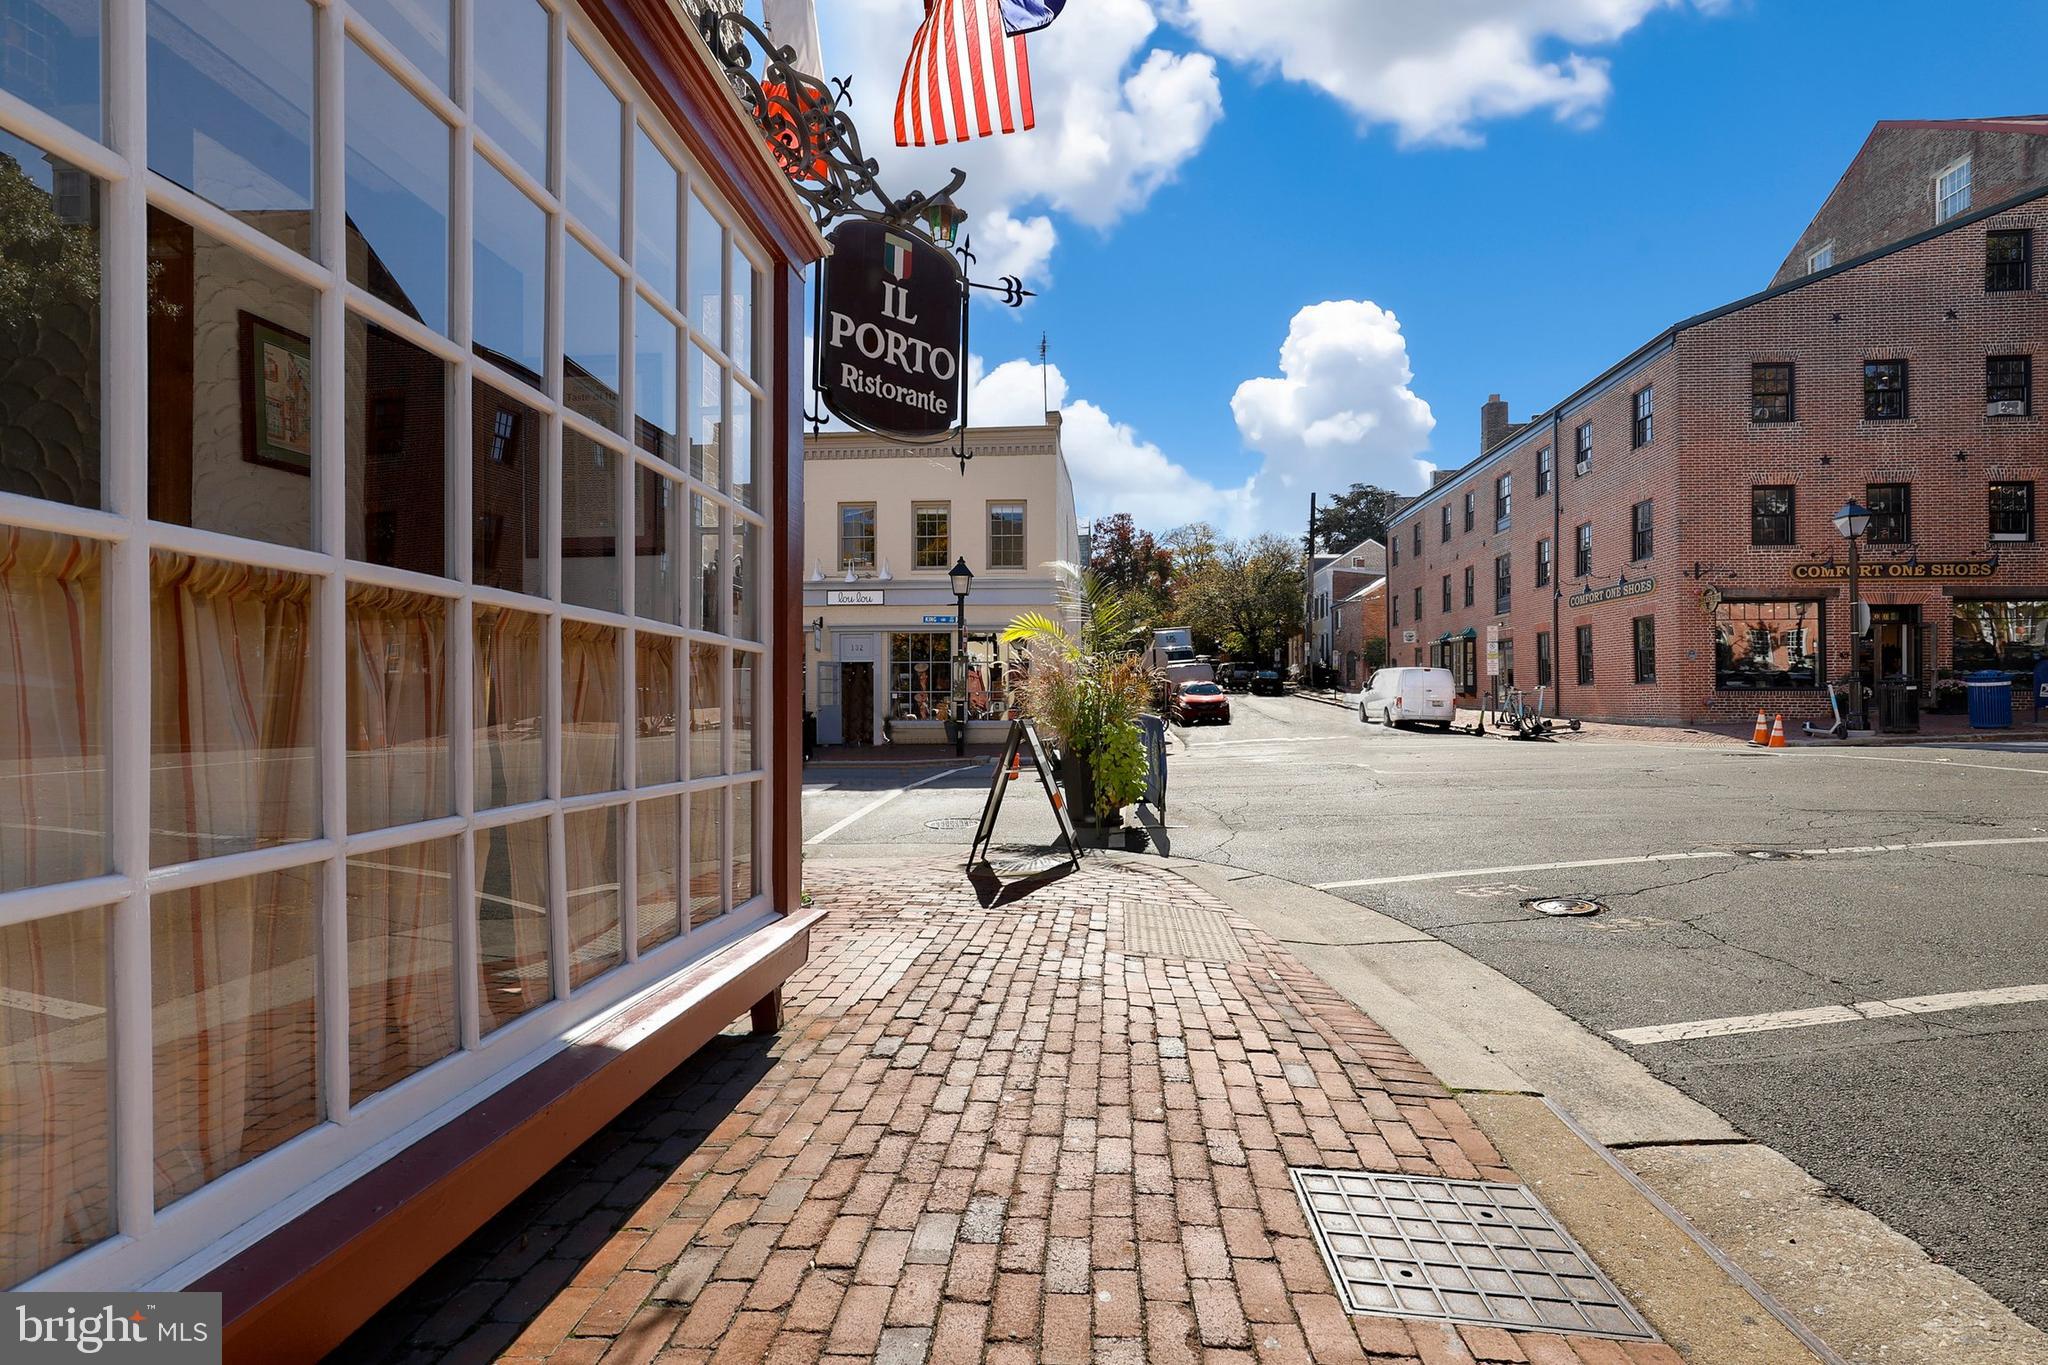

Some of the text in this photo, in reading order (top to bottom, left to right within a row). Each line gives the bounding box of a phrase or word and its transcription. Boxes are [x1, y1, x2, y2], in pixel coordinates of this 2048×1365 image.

[881, 280, 918, 325] IL
[829, 311, 956, 381] PORTO
[840, 363, 948, 415] Ristorante
[1888, 564, 1926, 576] ONE
[1930, 563, 1991, 576] SHOES
[838, 592, 874, 603] lou lou
[1570, 580, 1652, 606] COMFORT ONE SHOES
